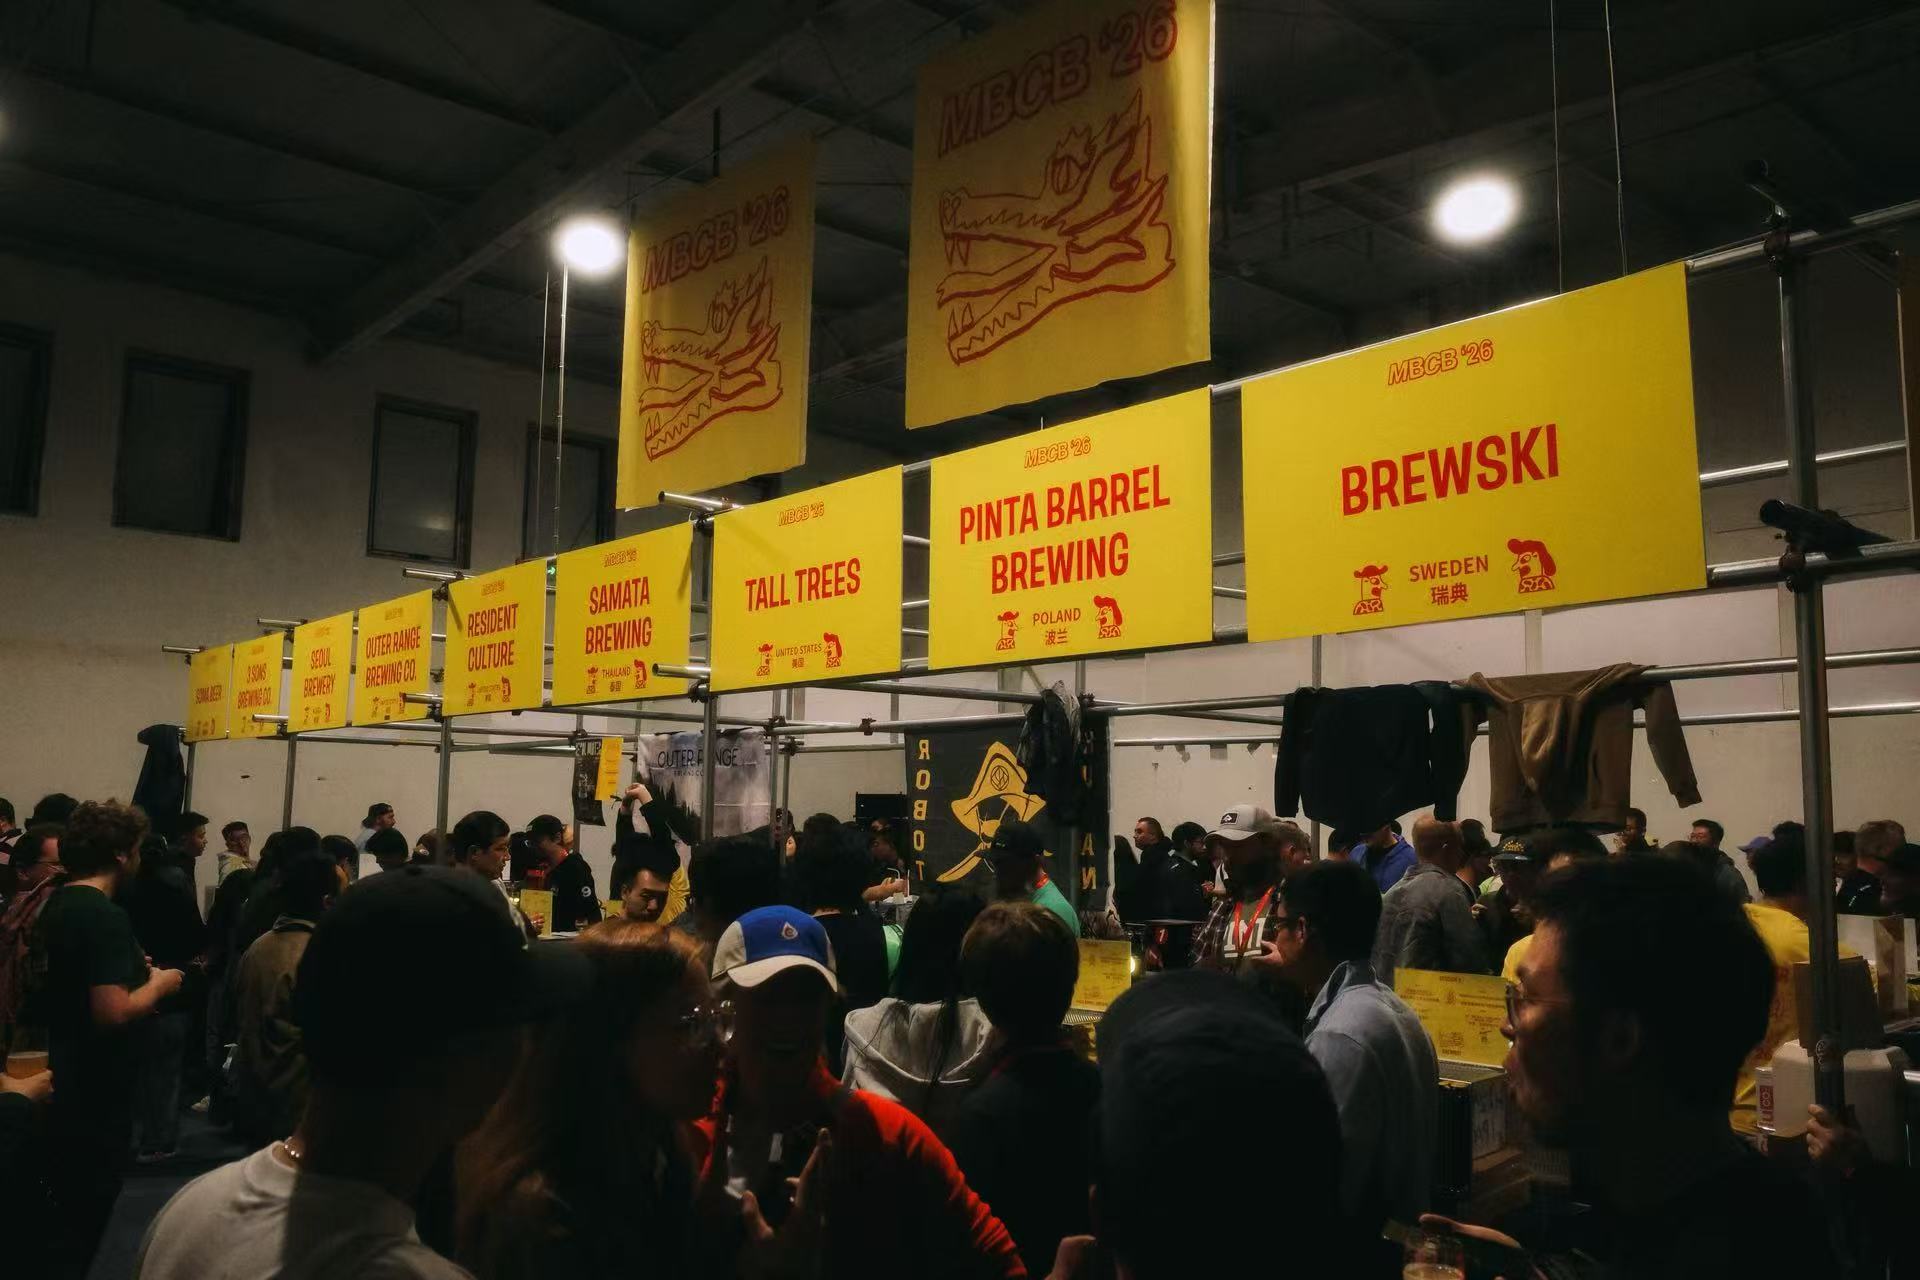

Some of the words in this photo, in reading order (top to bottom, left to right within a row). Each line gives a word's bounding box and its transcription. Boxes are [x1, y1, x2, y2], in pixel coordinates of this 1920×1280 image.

[937, 33, 1091, 158] MBCB
[642, 210, 741, 295] MBCB
[1387, 348, 1458, 386] MBCB
[1024, 442, 1069, 469] MBCB
[1341, 423, 1559, 516] BREWSKI
[778, 505, 810, 527] MBCB
[960, 492, 1039, 545] PINTA
[1046, 464, 1171, 529] BARREL
[991, 531, 1129, 595] BREWING
[1408, 555, 1489, 582] SWEDEN
[589, 576, 650, 616] SAMATA
[745, 573, 790, 612] TALL
[794, 557, 861, 603] TREES
[1430, 582, 1468, 606] 瑞典
[467, 603, 519, 638] RESIDENT
[1032, 607, 1082, 625] POLAND
[365, 629, 391, 660] OUTER
[393, 625, 421, 651] RANGE
[585, 616, 652, 655] BREWING
[775, 646, 798, 658] UNITED
[799, 643, 822, 655] STATES
[1044, 628, 1069, 646] 波兰
[311, 647, 332, 670] SEOUL
[467, 639, 515, 672] CULTURE
[303, 673, 336, 698] BREWERY
[365, 661, 402, 689] BREWING
[403, 659, 417, 682] CO.
[602, 666, 631, 678] THAILAND
[657, 749, 695, 768] OUTER
[697, 748, 739, 768] RNGE
